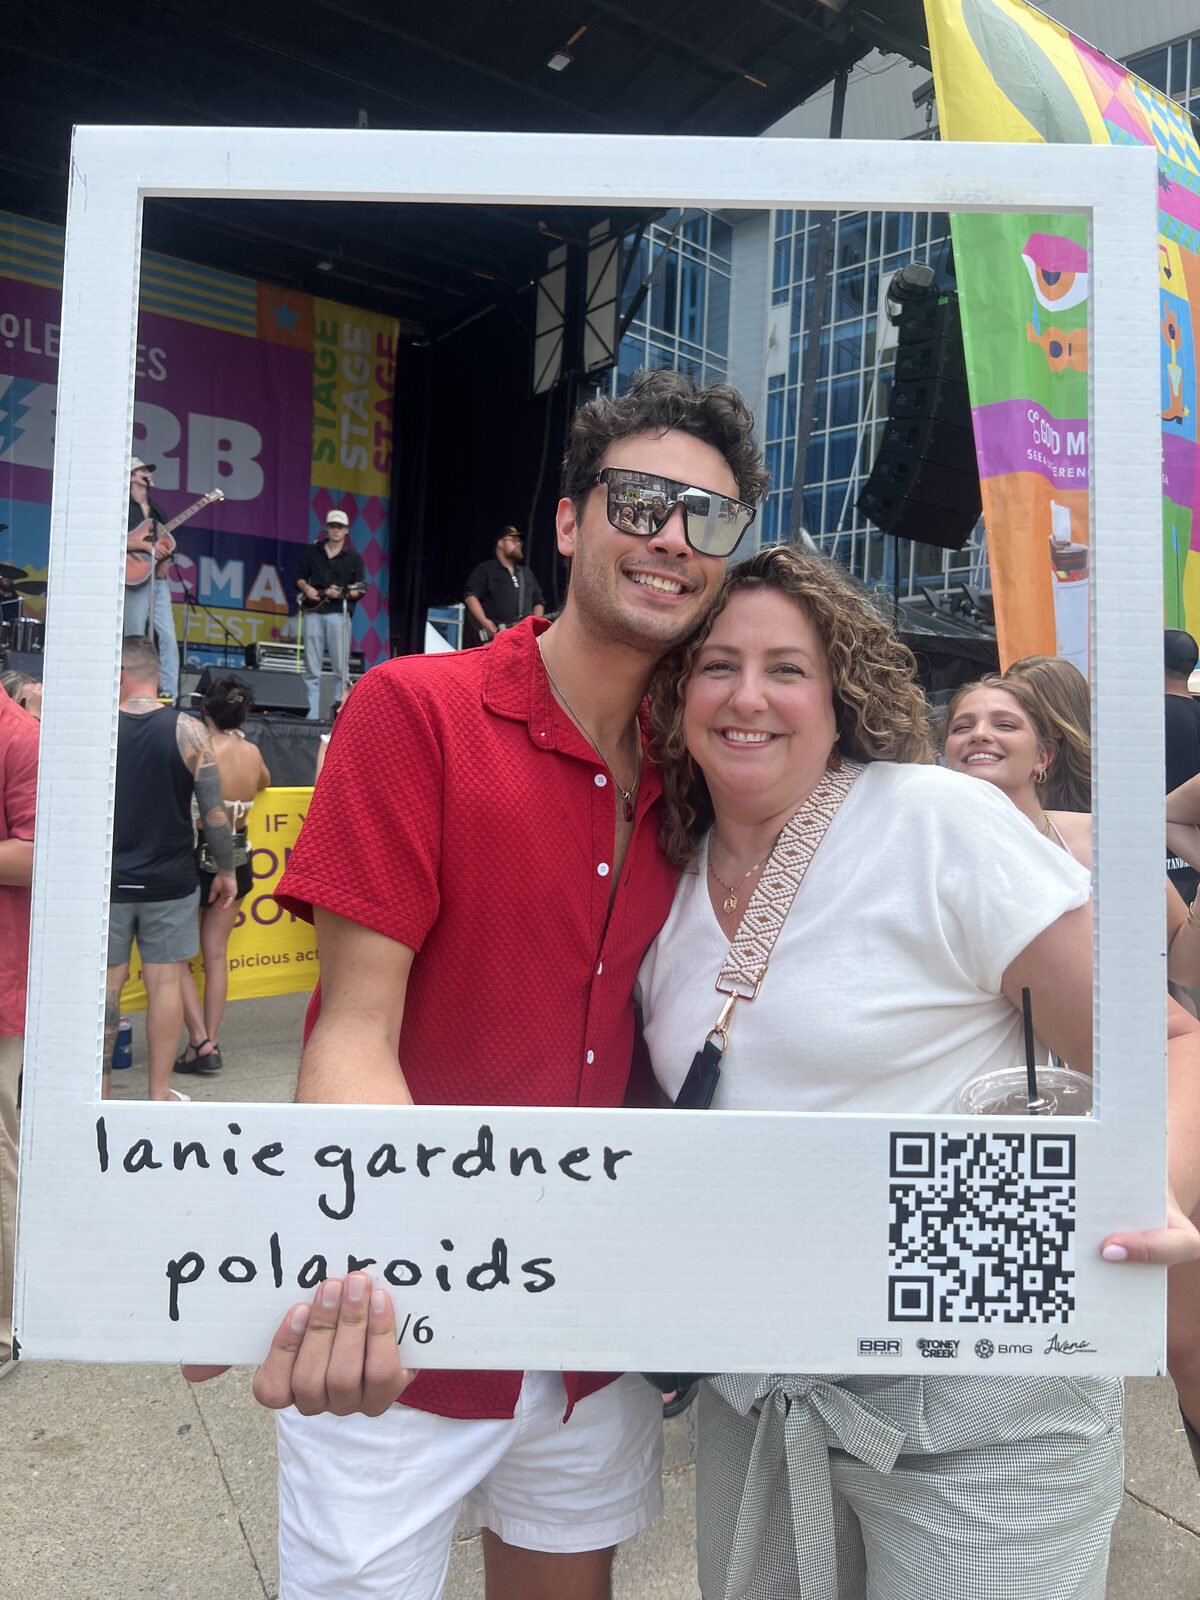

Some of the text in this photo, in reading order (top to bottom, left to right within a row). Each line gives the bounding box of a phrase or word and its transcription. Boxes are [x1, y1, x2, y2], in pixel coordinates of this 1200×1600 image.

[312, 320, 338, 464] STAGE
[340, 324, 371, 472] STAGE
[373, 332, 397, 474] STAGE
[166, 553, 288, 606] CMA
[185, 610, 264, 642] FEST
[266, 814, 289, 832] IF
[229, 951, 290, 972] picious
[95, 1116, 634, 1220] lanie gardner
[166, 1232, 556, 1321] polaroids
[860, 1340, 899, 1351] BBR
[918, 1340, 960, 1349] STONEY
[921, 1349, 955, 1358] CREEK
[998, 1344, 1032, 1354] BMG
